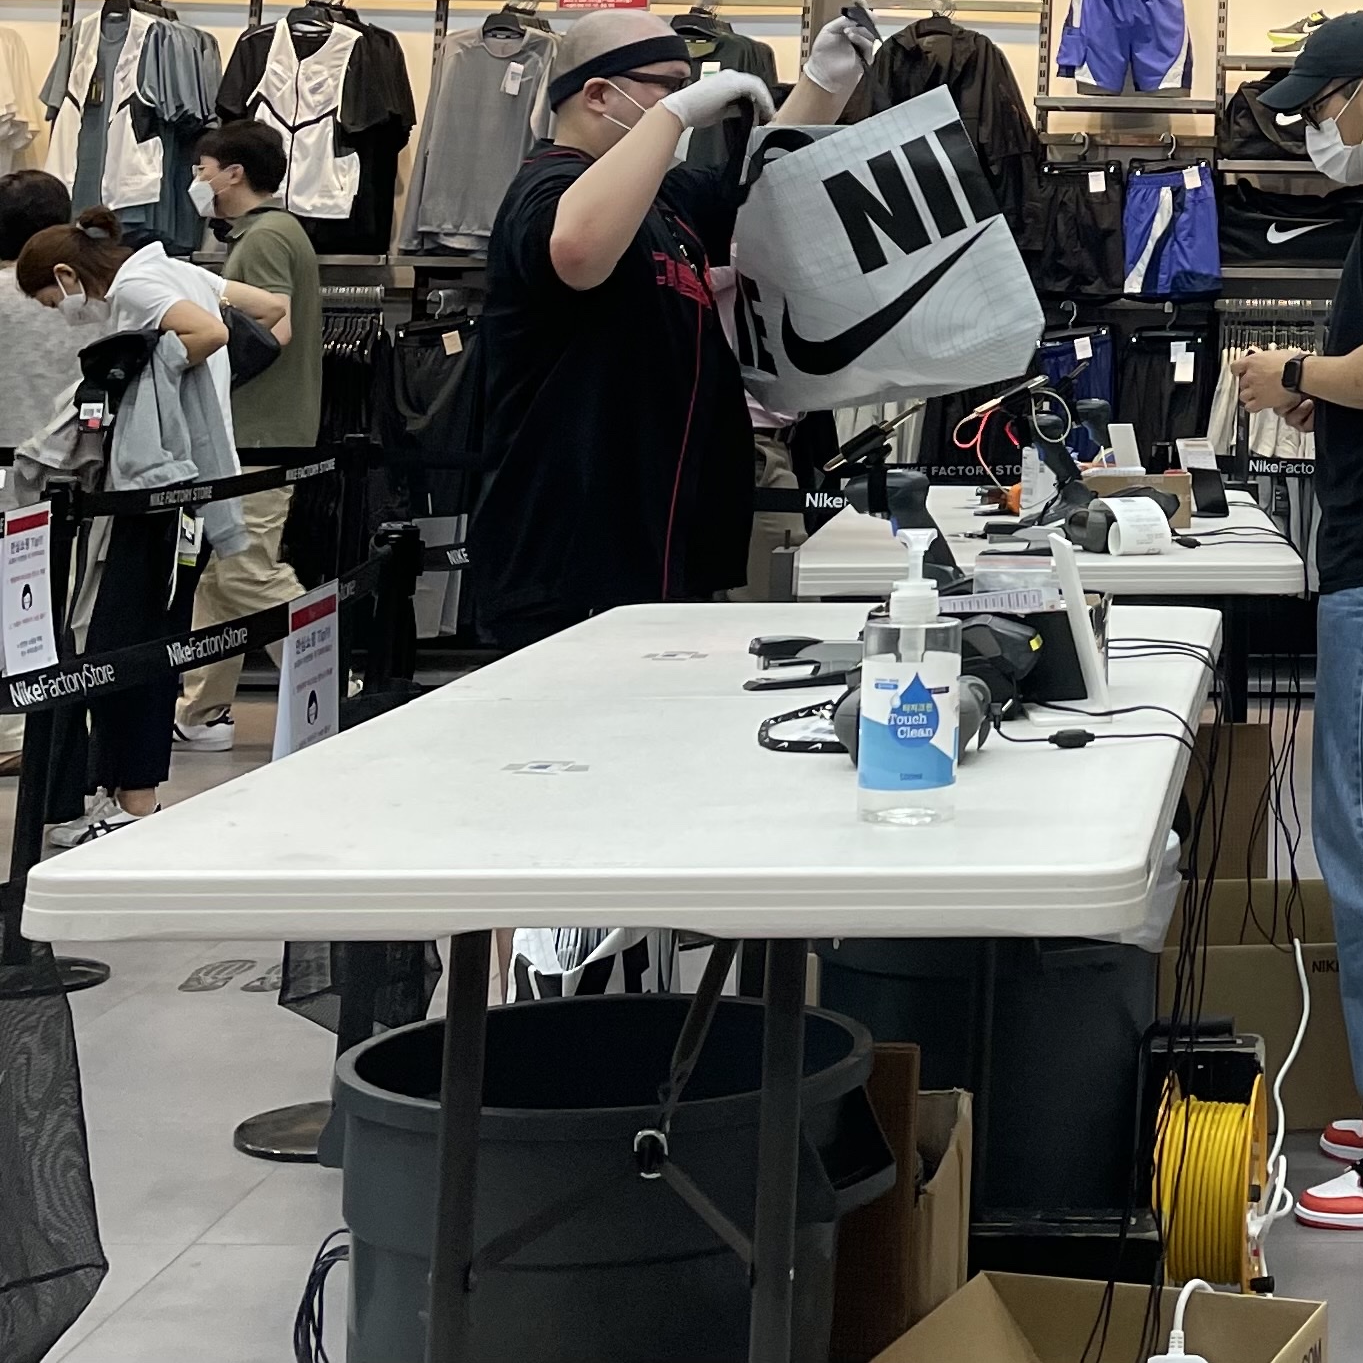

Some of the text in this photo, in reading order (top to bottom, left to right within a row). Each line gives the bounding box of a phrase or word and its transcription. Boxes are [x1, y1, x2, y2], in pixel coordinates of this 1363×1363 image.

[9, 663, 115, 708] NikeFactoryStore
[889, 713, 928, 725] Touch
[897, 726, 933, 739] Clean
